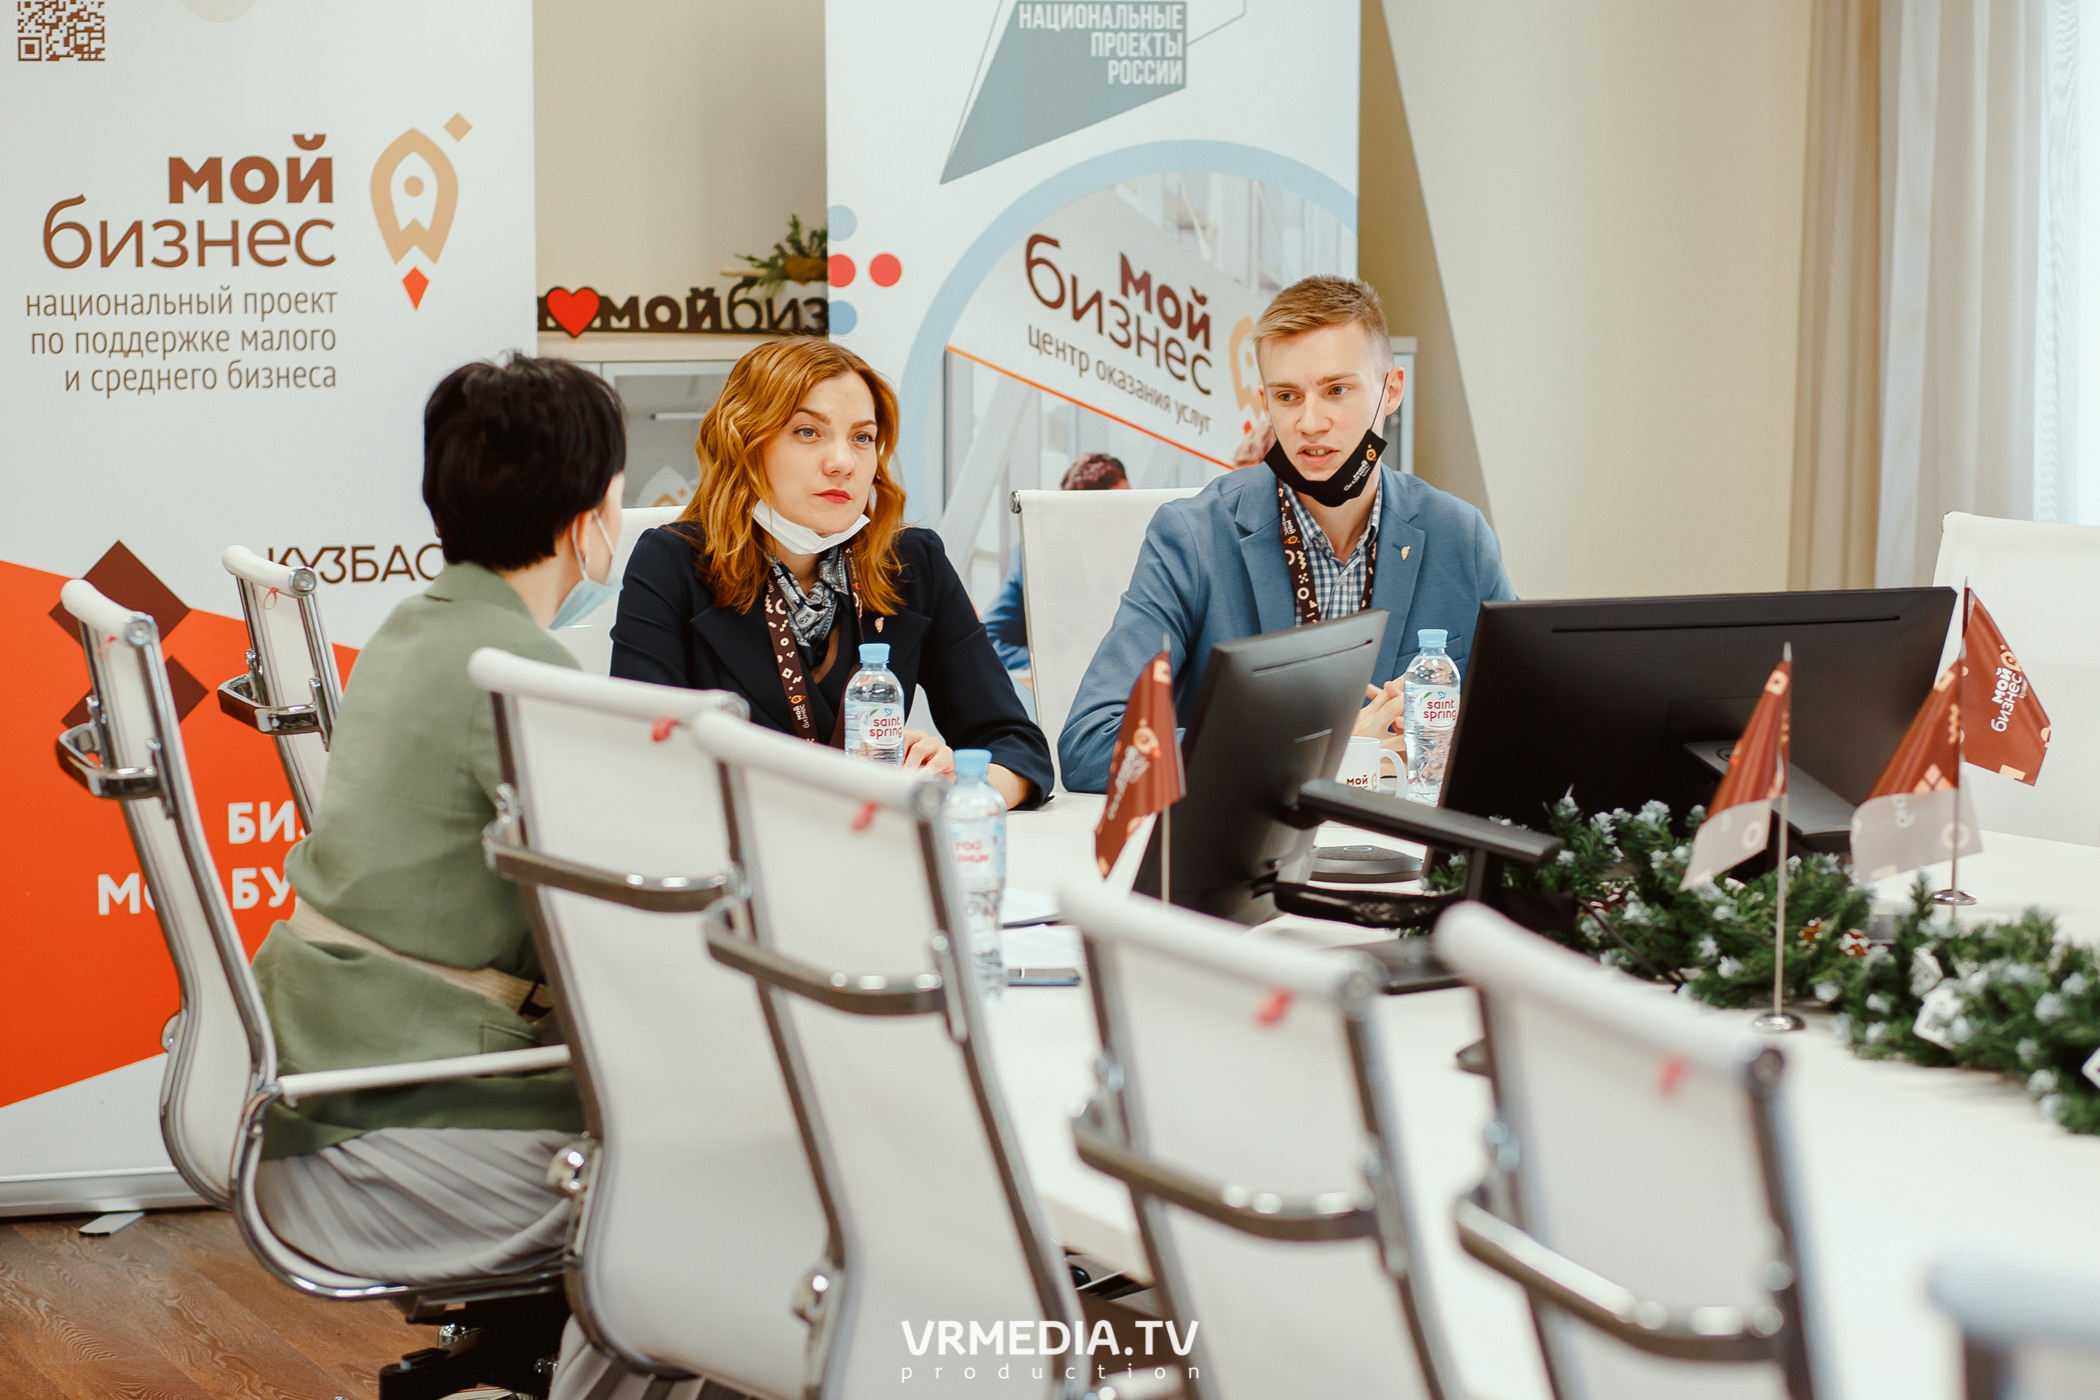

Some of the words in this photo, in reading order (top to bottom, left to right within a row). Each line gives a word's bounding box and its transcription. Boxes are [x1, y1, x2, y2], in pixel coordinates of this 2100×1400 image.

[1018, 3, 1184, 32] НАЦИОНАЛЬНЫЕ
[1090, 31, 1184, 58] ПРОЕКТЫ
[1107, 59, 1183, 85] РОССИИ
[168, 133, 334, 205] мой
[42, 193, 337, 269] бизнес
[25, 285, 234, 320] национальный
[243, 290, 339, 322] проект
[1026, 233, 1213, 396] бизнес
[1119, 251, 1210, 352] мой
[30, 330, 65, 355] по
[74, 327, 231, 359] поддержке
[241, 326, 337, 353] малого
[64, 367, 81, 392] и
[90, 364, 218, 399] среднего
[227, 358, 337, 390] бизнеса
[1027, 323, 1091, 378] центр
[1095, 359, 1172, 415] оказания
[1174, 399, 1213, 436] услуг
[1990, 672, 2023, 732] бизнес
[1991, 667, 2013, 704] мой
[873, 716, 901, 727] saint
[1422, 709, 1457, 722] spring
[1426, 699, 1455, 710] saint
[869, 726, 903, 741] spring
[1346, 774, 1369, 786] мой
[228, 800, 307, 845] БИ
